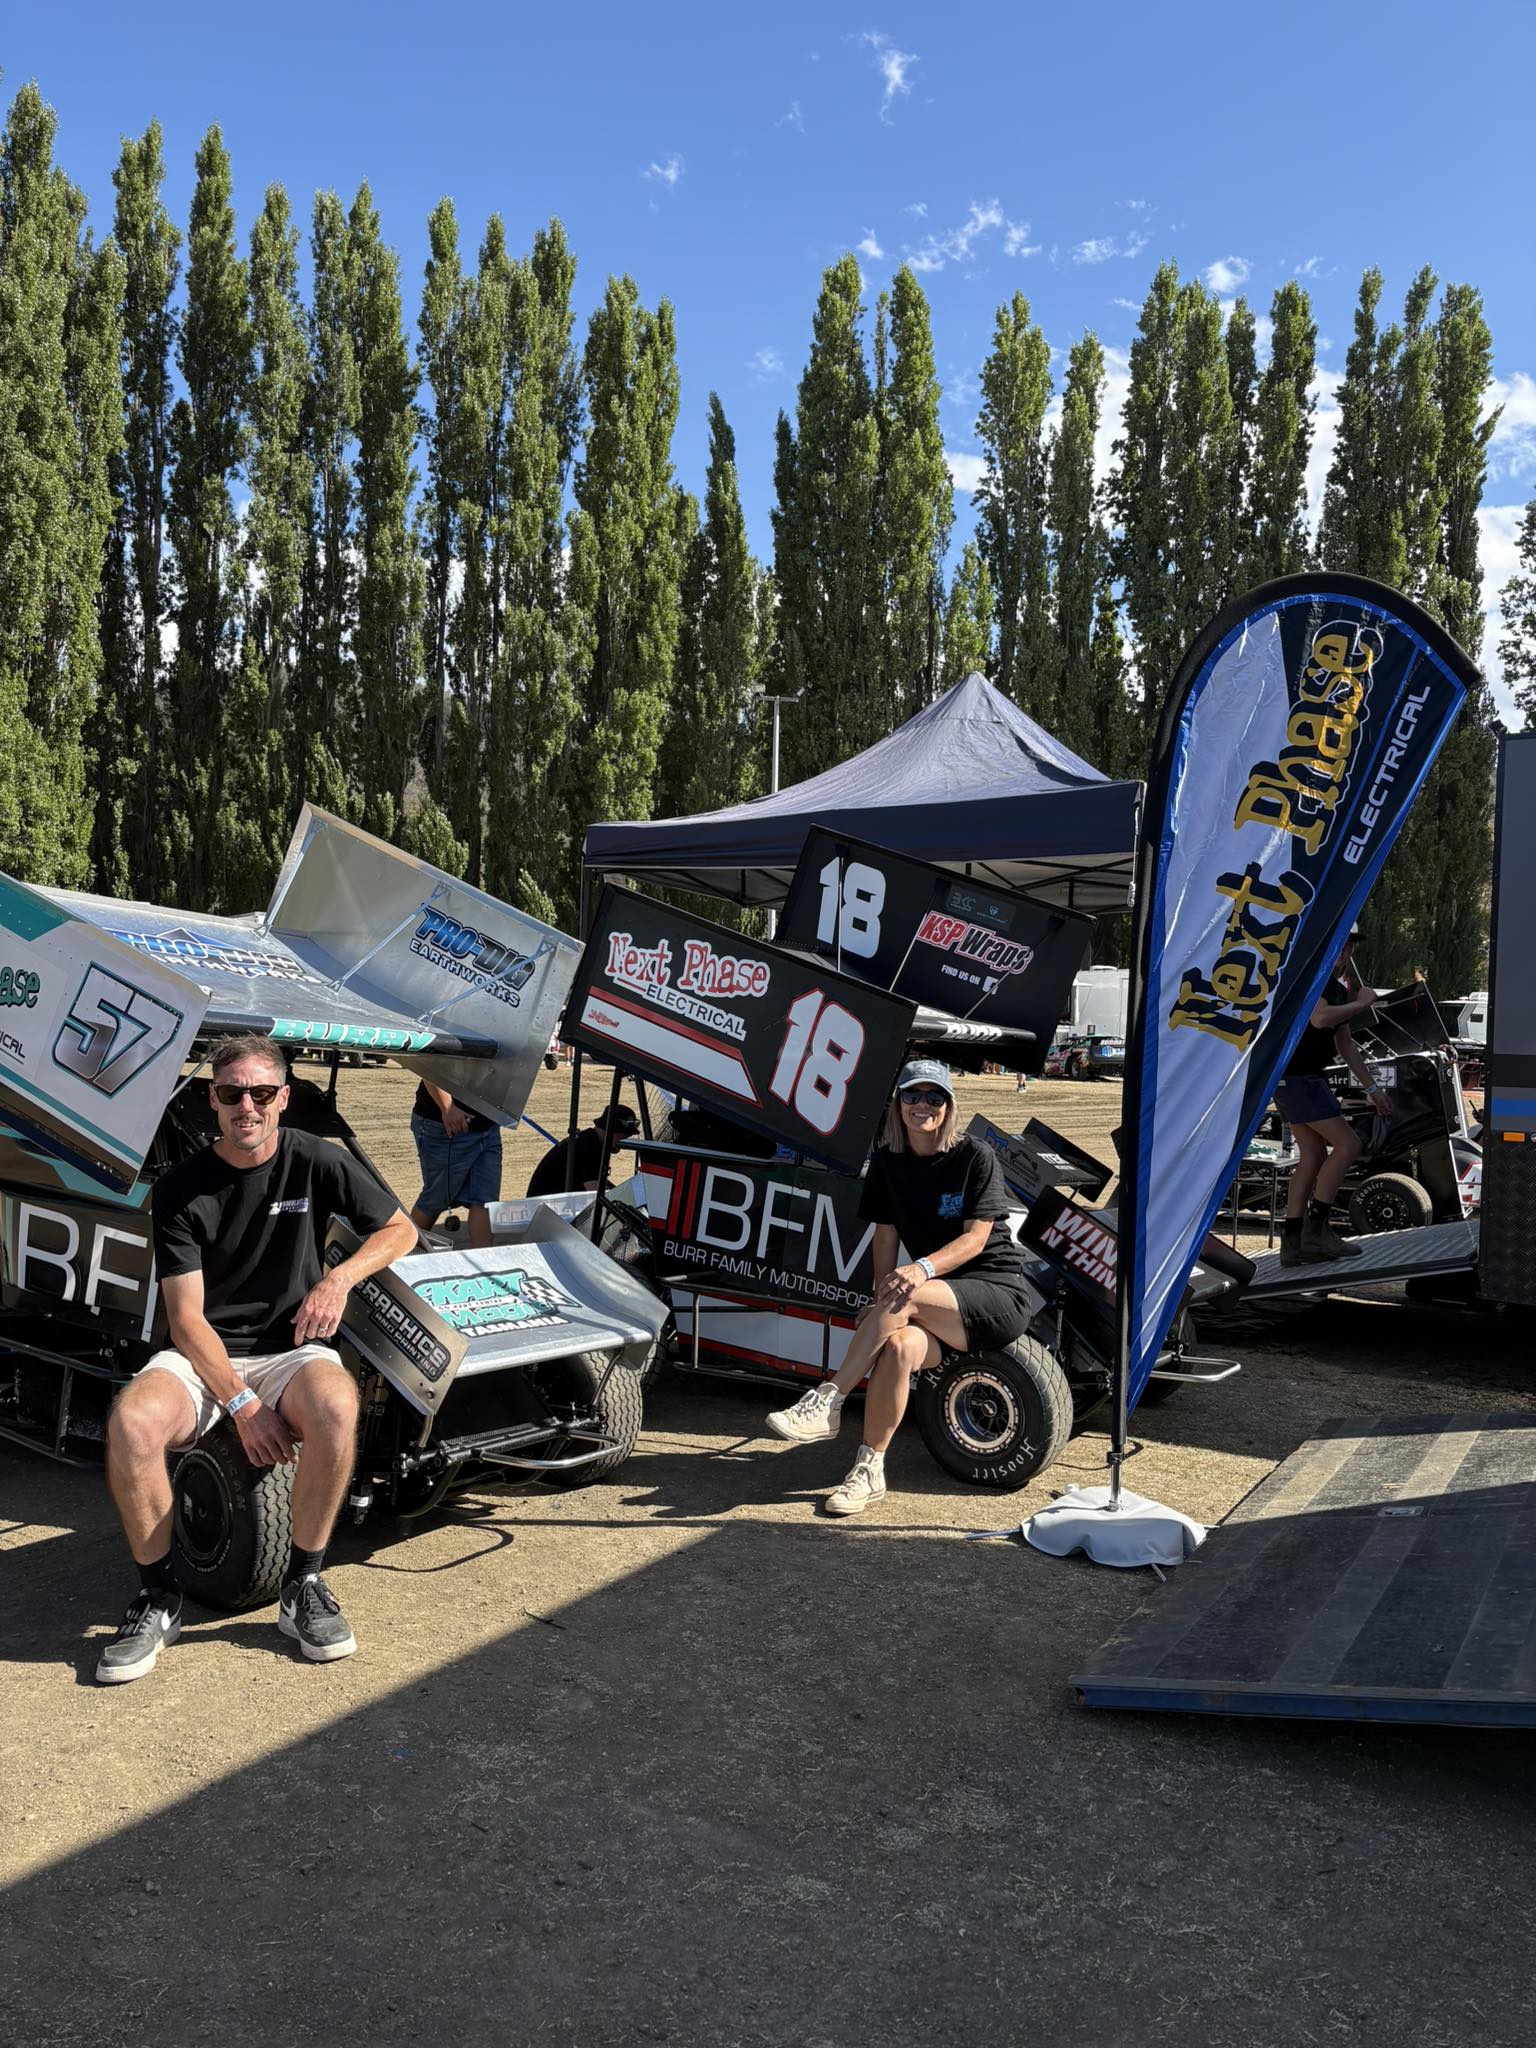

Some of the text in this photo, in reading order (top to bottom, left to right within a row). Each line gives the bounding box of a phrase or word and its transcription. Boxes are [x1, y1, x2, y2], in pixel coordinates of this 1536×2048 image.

[1343, 686, 1431, 865] ELECTRICAL
[1169, 624, 1380, 1052] Next Phase
[817, 856, 886, 958] 18
[409, 938, 520, 1008] EARTHWORKS
[416, 905, 535, 991] PRO-DIG
[606, 933, 769, 996] Next Phase
[917, 912, 1032, 973] KSP Wraps
[0, 966, 40, 1008] ase
[941, 964, 981, 985] FIND US ON
[53, 960, 184, 1099] 57
[268, 1017, 436, 1051] BURRY
[646, 984, 746, 1037] ELECTRICAL
[0, 1030, 26, 1058] ICAL
[768, 987, 866, 1137] 18
[414, 1271, 526, 1306] KART
[664, 1240, 874, 1309] BURR FAMILY MOTORSPOR
[1063, 1242, 1118, 1293] THIN
[374, 1313, 437, 1377] AND PRINTING
[459, 1314, 570, 1338] TASMANIA
